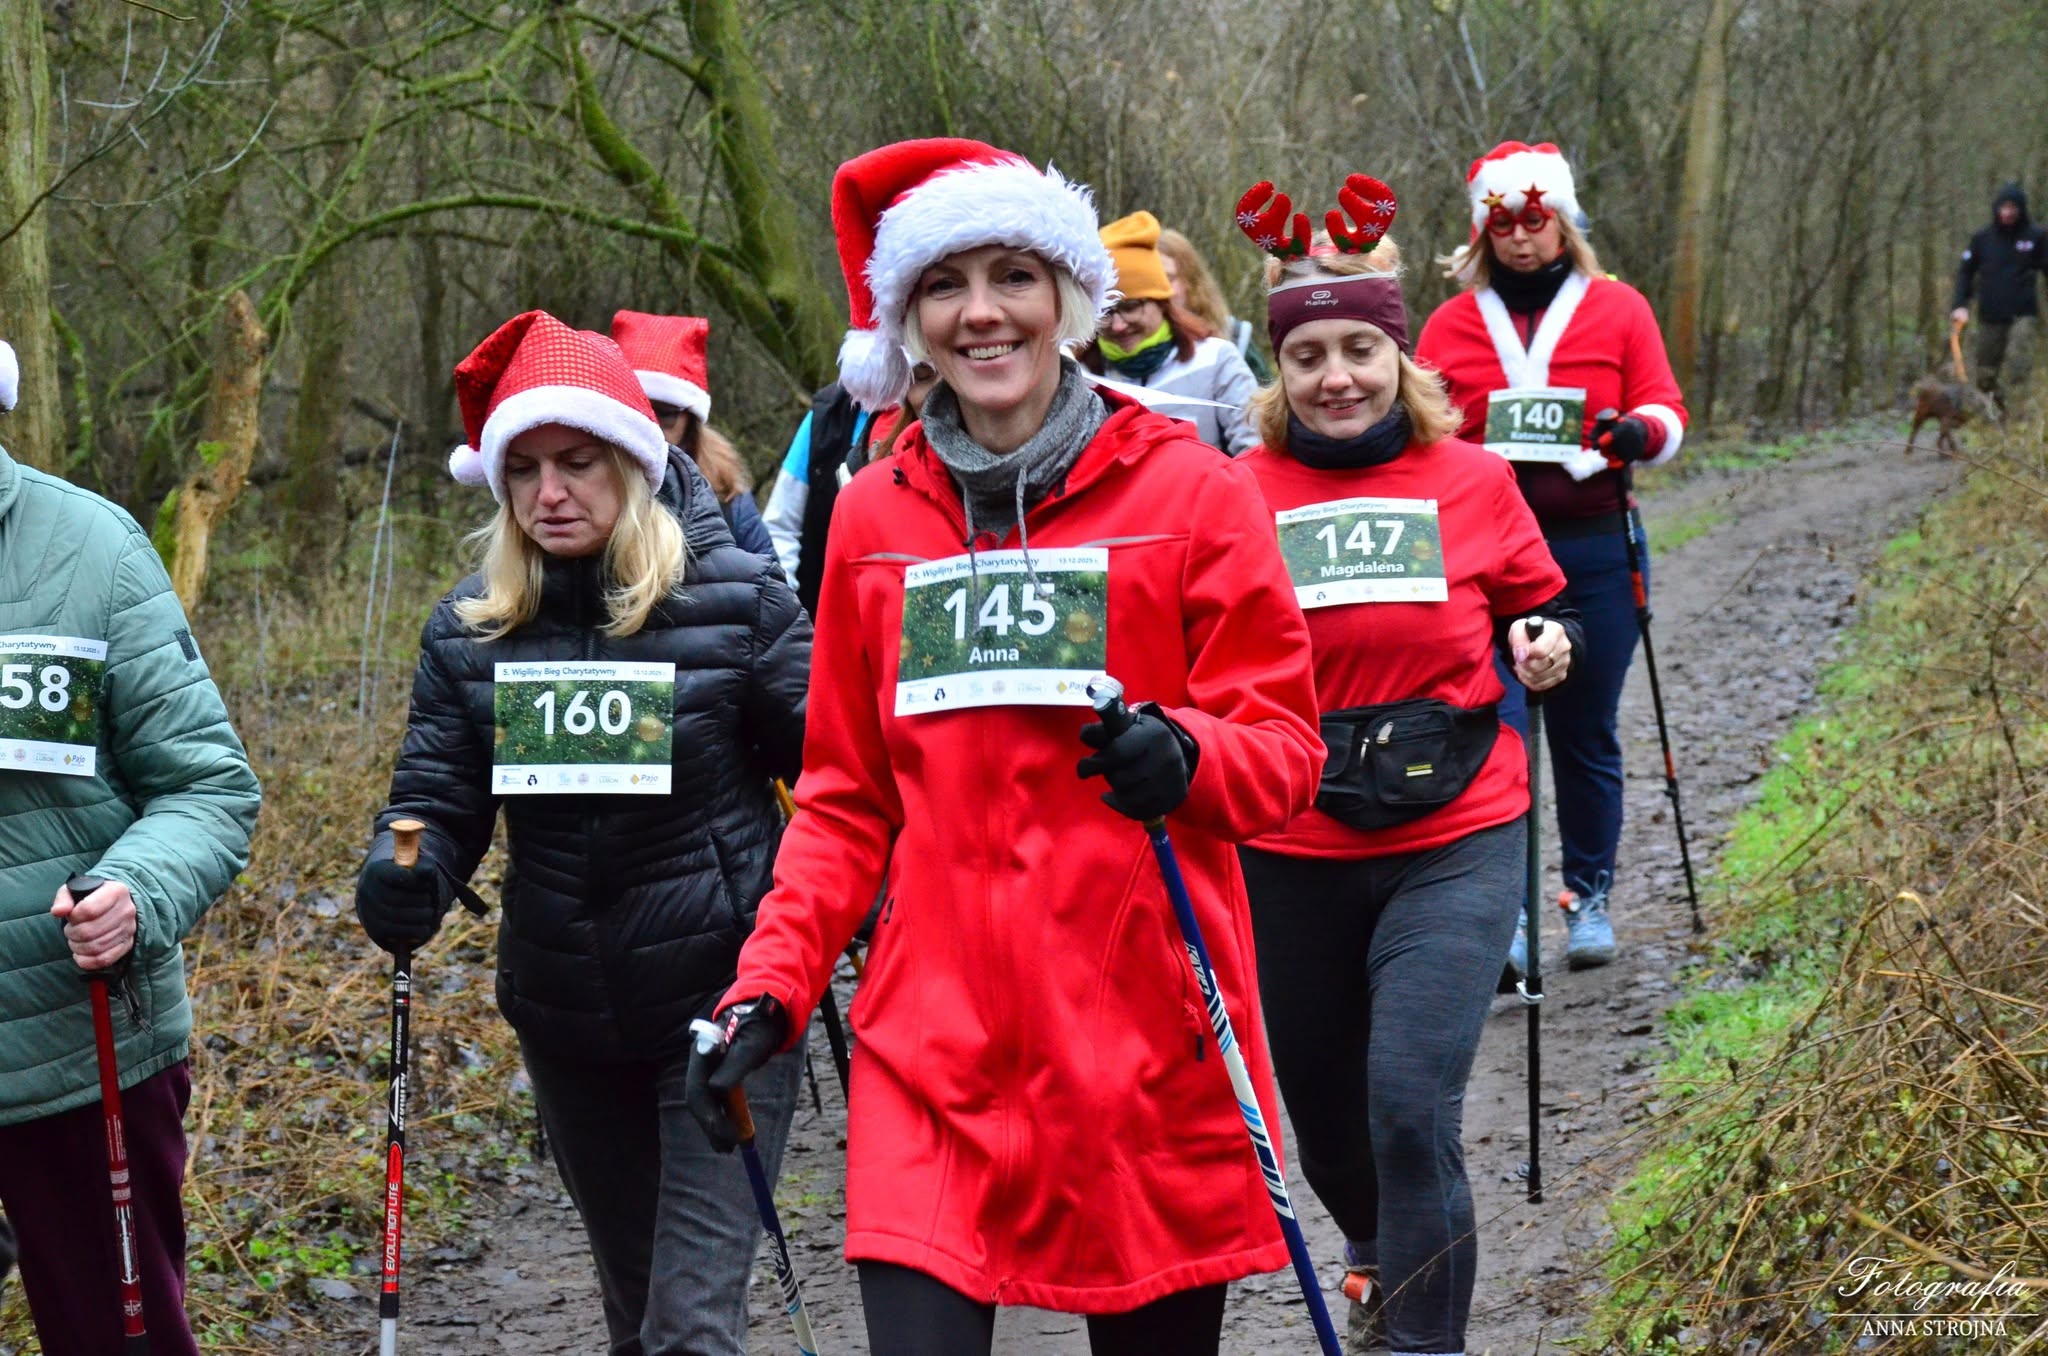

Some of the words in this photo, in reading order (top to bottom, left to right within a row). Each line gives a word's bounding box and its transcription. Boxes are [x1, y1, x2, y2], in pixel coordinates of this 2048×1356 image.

[1304, 298, 1339, 306] Kalenji
[1508, 402, 1564, 430] 140
[1315, 520, 1405, 559] 147
[922, 565, 953, 579] Wigilijny
[1320, 561, 1405, 578] Magdalena
[943, 583, 1056, 640] 145
[969, 646, 1019, 664] Anna
[512, 667, 542, 677] Wigilijny
[544, 667, 560, 677] Bieg
[562, 667, 616, 677] Charytatywny
[533, 690, 632, 735] 160
[389, 1182, 399, 1207] LITE
